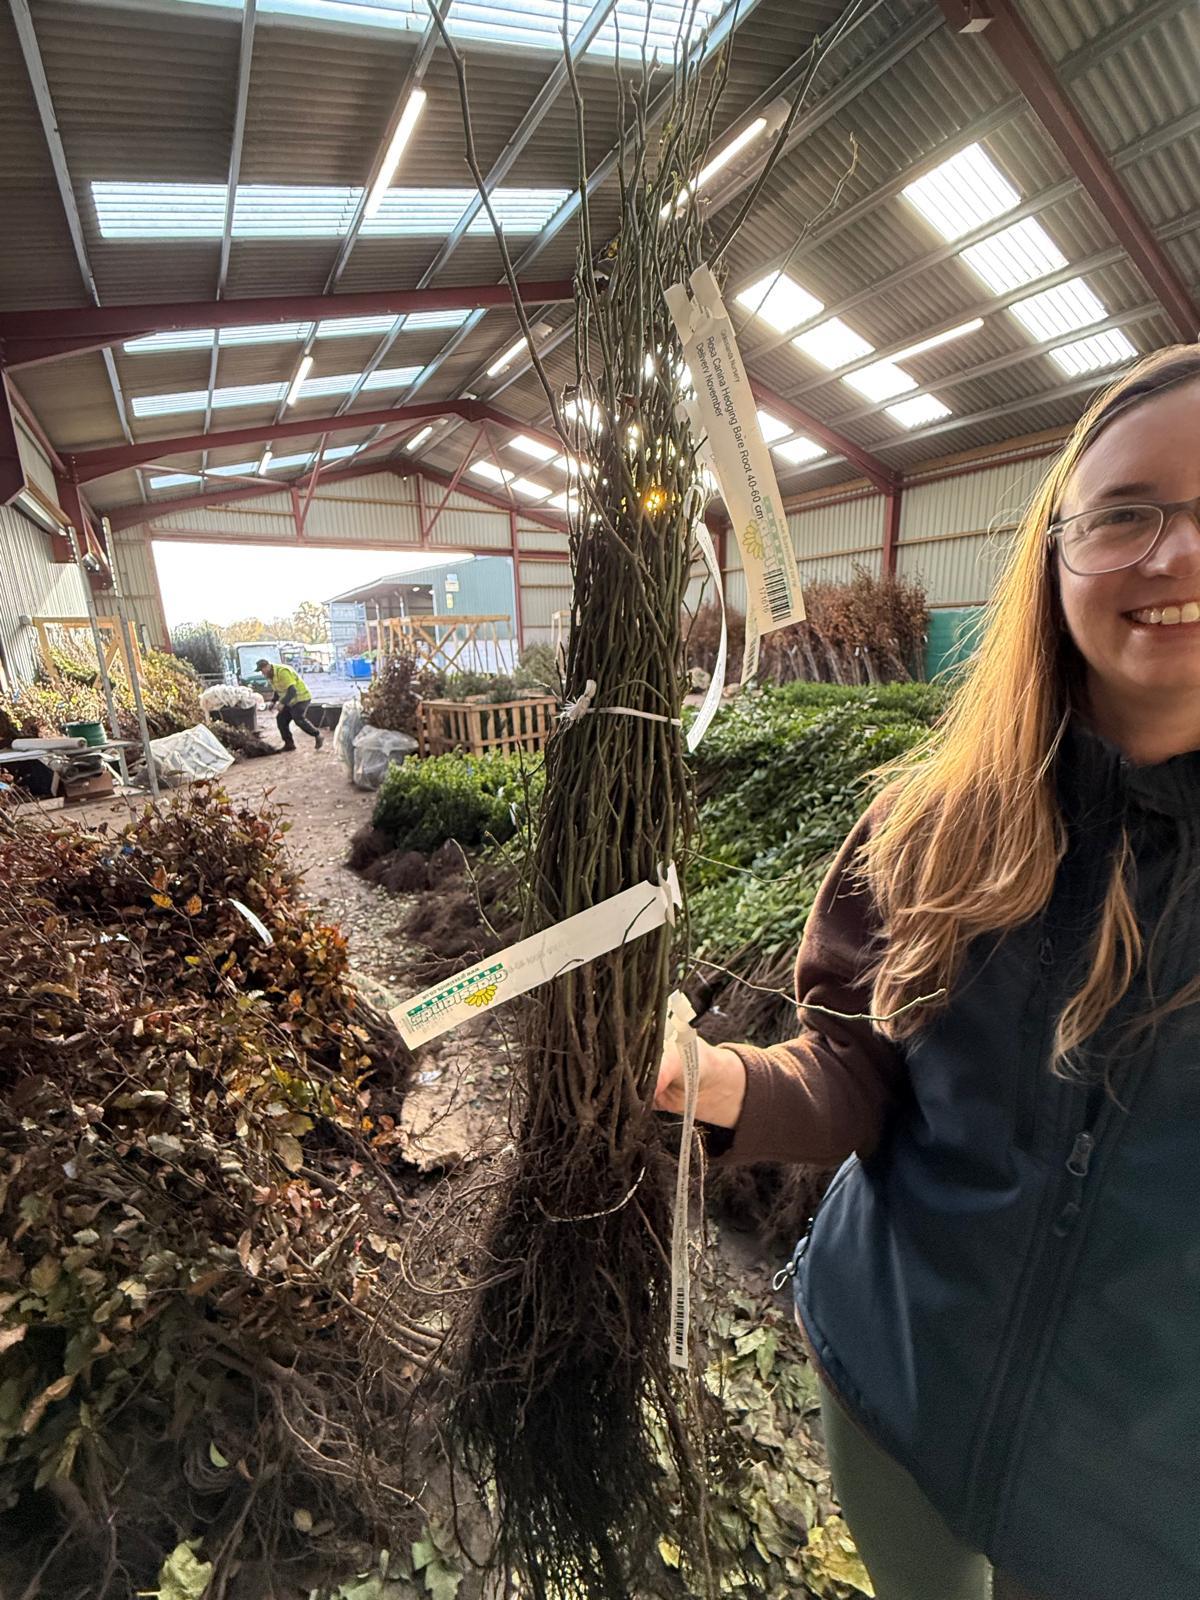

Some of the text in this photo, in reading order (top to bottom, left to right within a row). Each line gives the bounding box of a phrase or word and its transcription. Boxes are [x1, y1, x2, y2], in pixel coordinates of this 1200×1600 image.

[696, 342, 723, 417] Delivery November
[707, 336, 764, 520] Rosa Canina Hedging Bare Root 40-60 cm
[410, 968, 509, 1027] Grasslands
